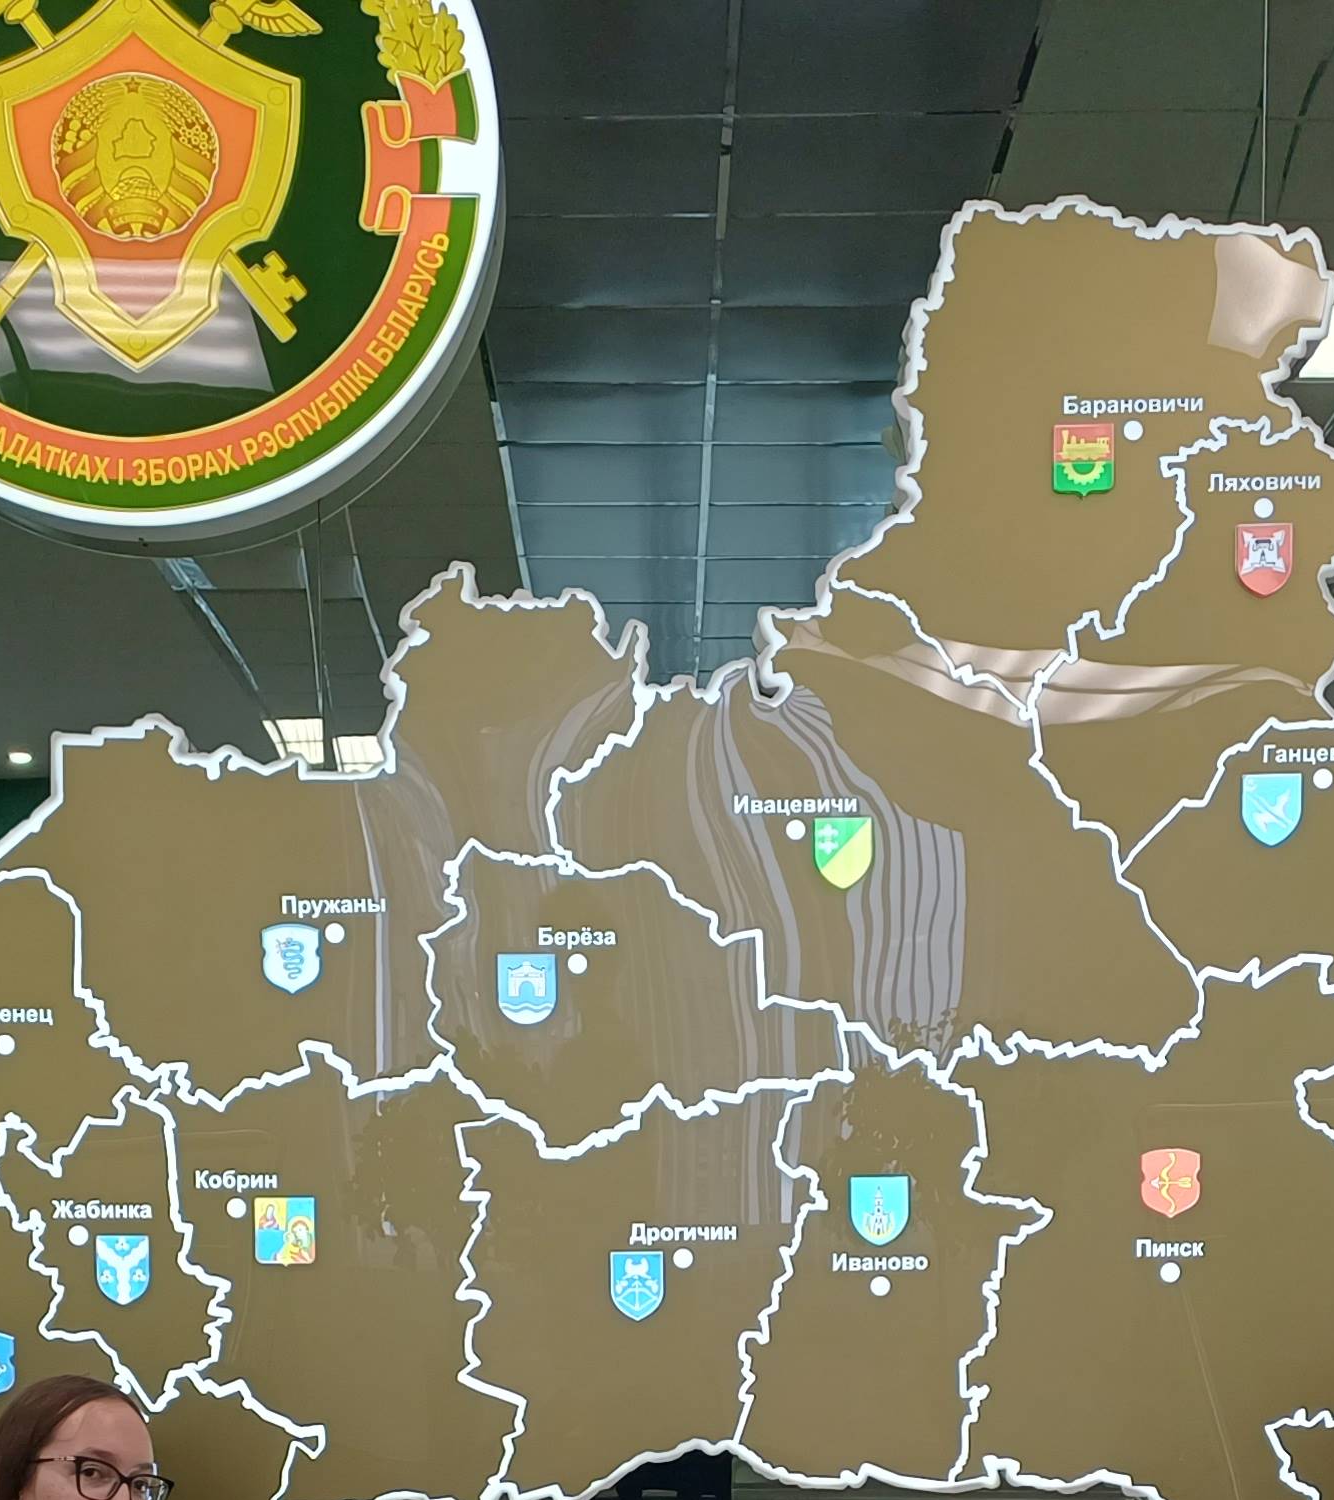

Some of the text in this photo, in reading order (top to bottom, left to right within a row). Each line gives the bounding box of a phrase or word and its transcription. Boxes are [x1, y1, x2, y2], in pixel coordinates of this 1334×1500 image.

[131, 443, 242, 488] ЗБОРАХ
[240, 358, 380, 466] РЭСПУБЛІКІ
[366, 231, 450, 368] БЕЛАРУСЬ
[1063, 395, 1204, 416] Барановичи
[1207, 473, 1321, 493] Ляховичи
[733, 794, 858, 816] Ивацевичи
[281, 894, 387, 917] Пружаны
[538, 926, 617, 948] Берёза
[195, 1169, 278, 1191] Кобрин
[51, 1199, 153, 1219] Жабинка
[629, 1222, 737, 1246] Дрогичин
[1136, 1238, 1204, 1258] Пинск
[832, 1252, 929, 1272] Иваново
